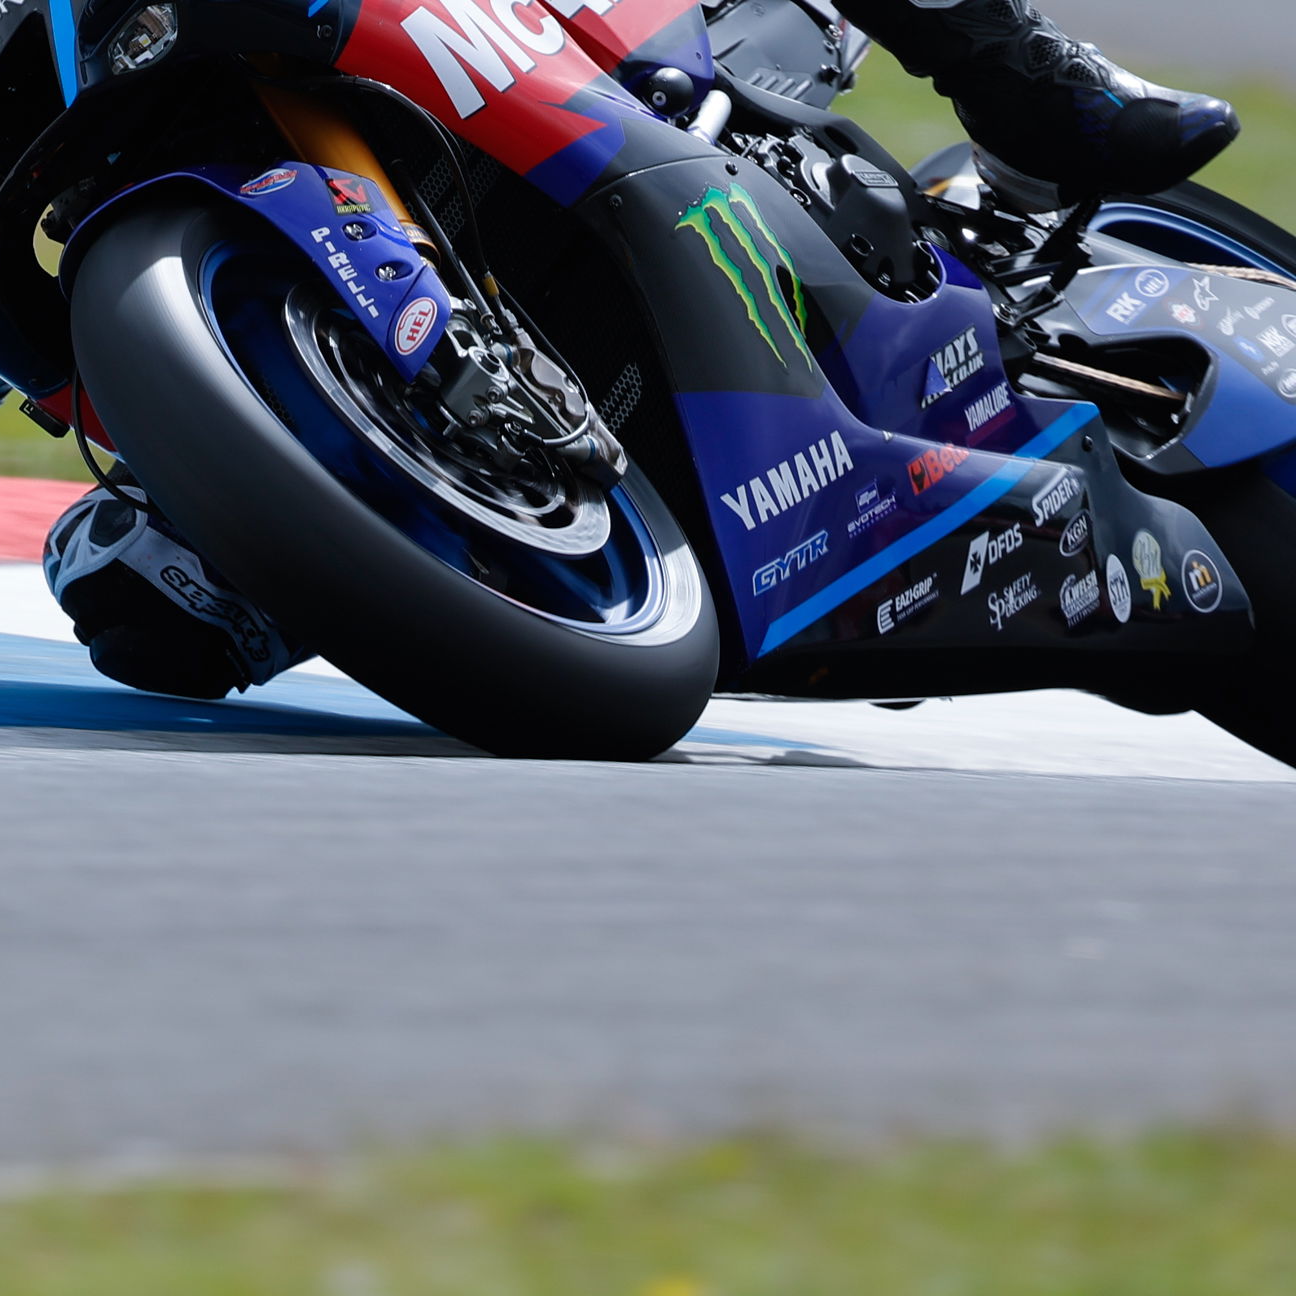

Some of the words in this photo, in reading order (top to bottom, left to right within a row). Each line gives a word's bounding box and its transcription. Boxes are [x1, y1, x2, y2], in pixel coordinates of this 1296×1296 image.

[311, 226, 379, 319] PIRELLI
[407, 308, 431, 342] HEL
[1106, 292, 1145, 324] RK
[964, 381, 1011, 432] YAMALUBE
[720, 430, 854, 532] YAMAHA
[1032, 467, 1073, 527] SPIDER
[847, 494, 897, 533] EVOTECH
[752, 529, 829, 597] GYTR
[988, 522, 1023, 565] DFDS
[1004, 571, 1032, 602] SAFETY
[1006, 584, 1038, 618] DECKING
